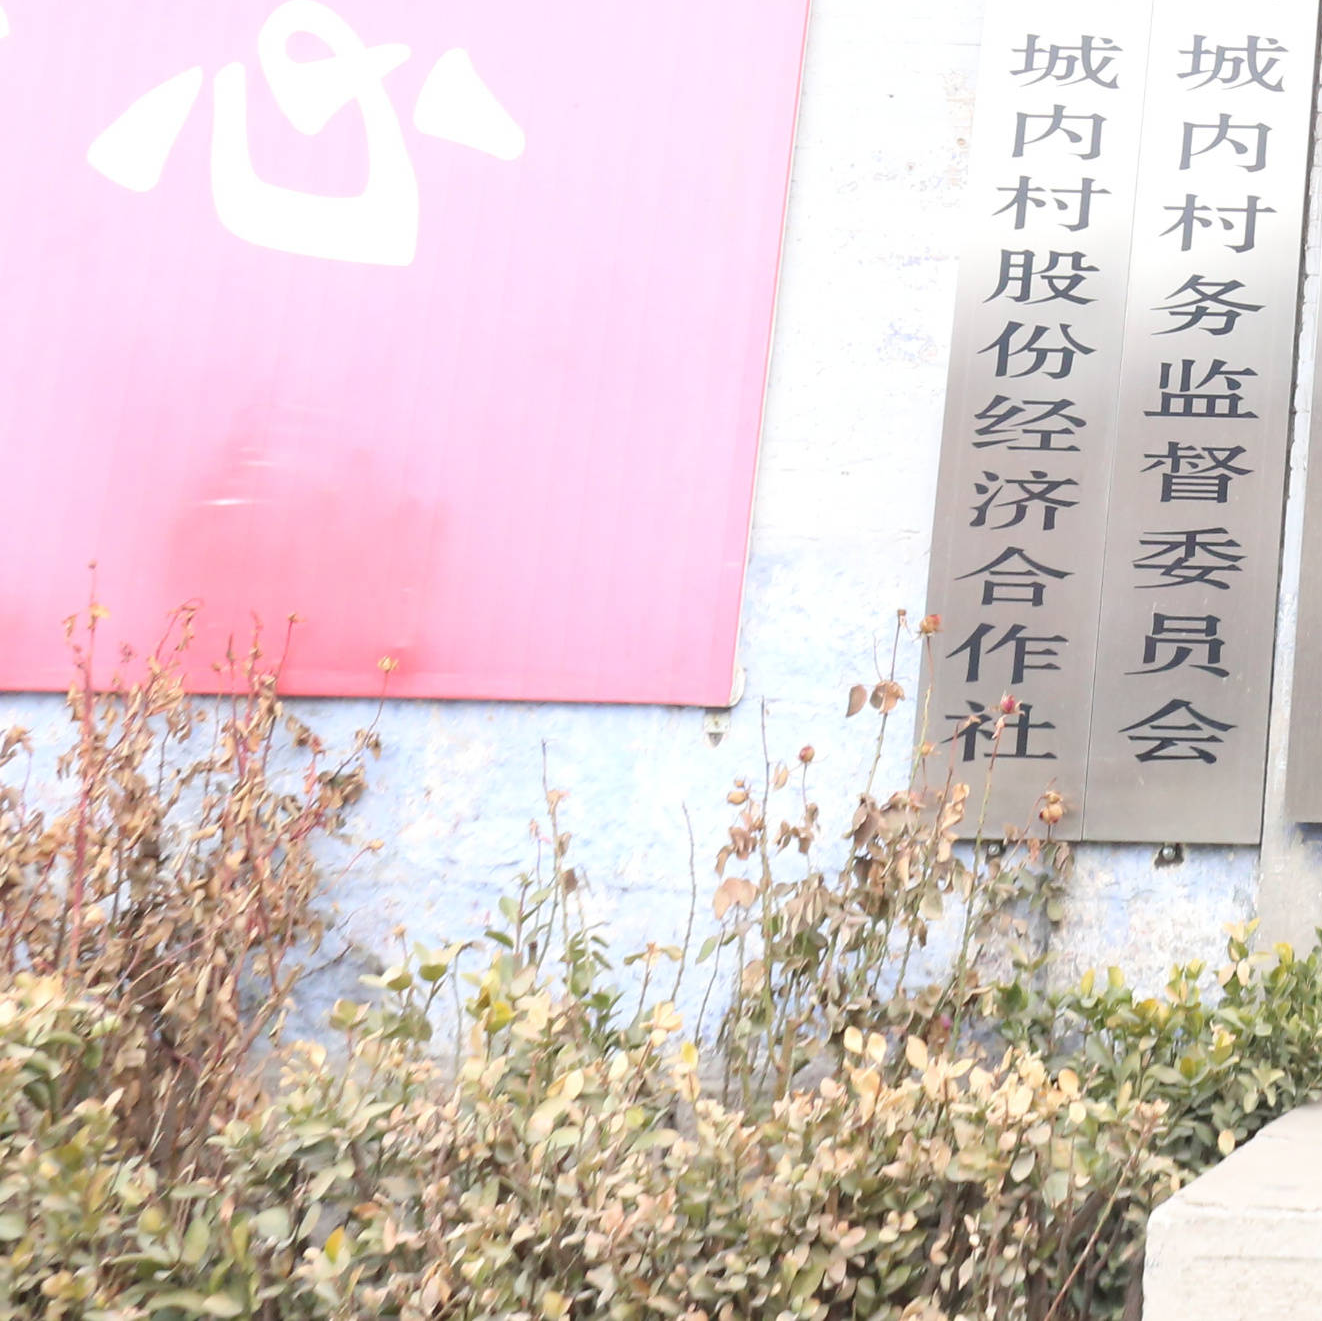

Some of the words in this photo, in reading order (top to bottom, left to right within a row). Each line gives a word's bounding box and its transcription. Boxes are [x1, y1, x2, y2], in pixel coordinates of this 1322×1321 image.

[941, 32, 1121, 764] 城内村股份经济合作社
[1117, 33, 1287, 765] 城内村务监督委员会
